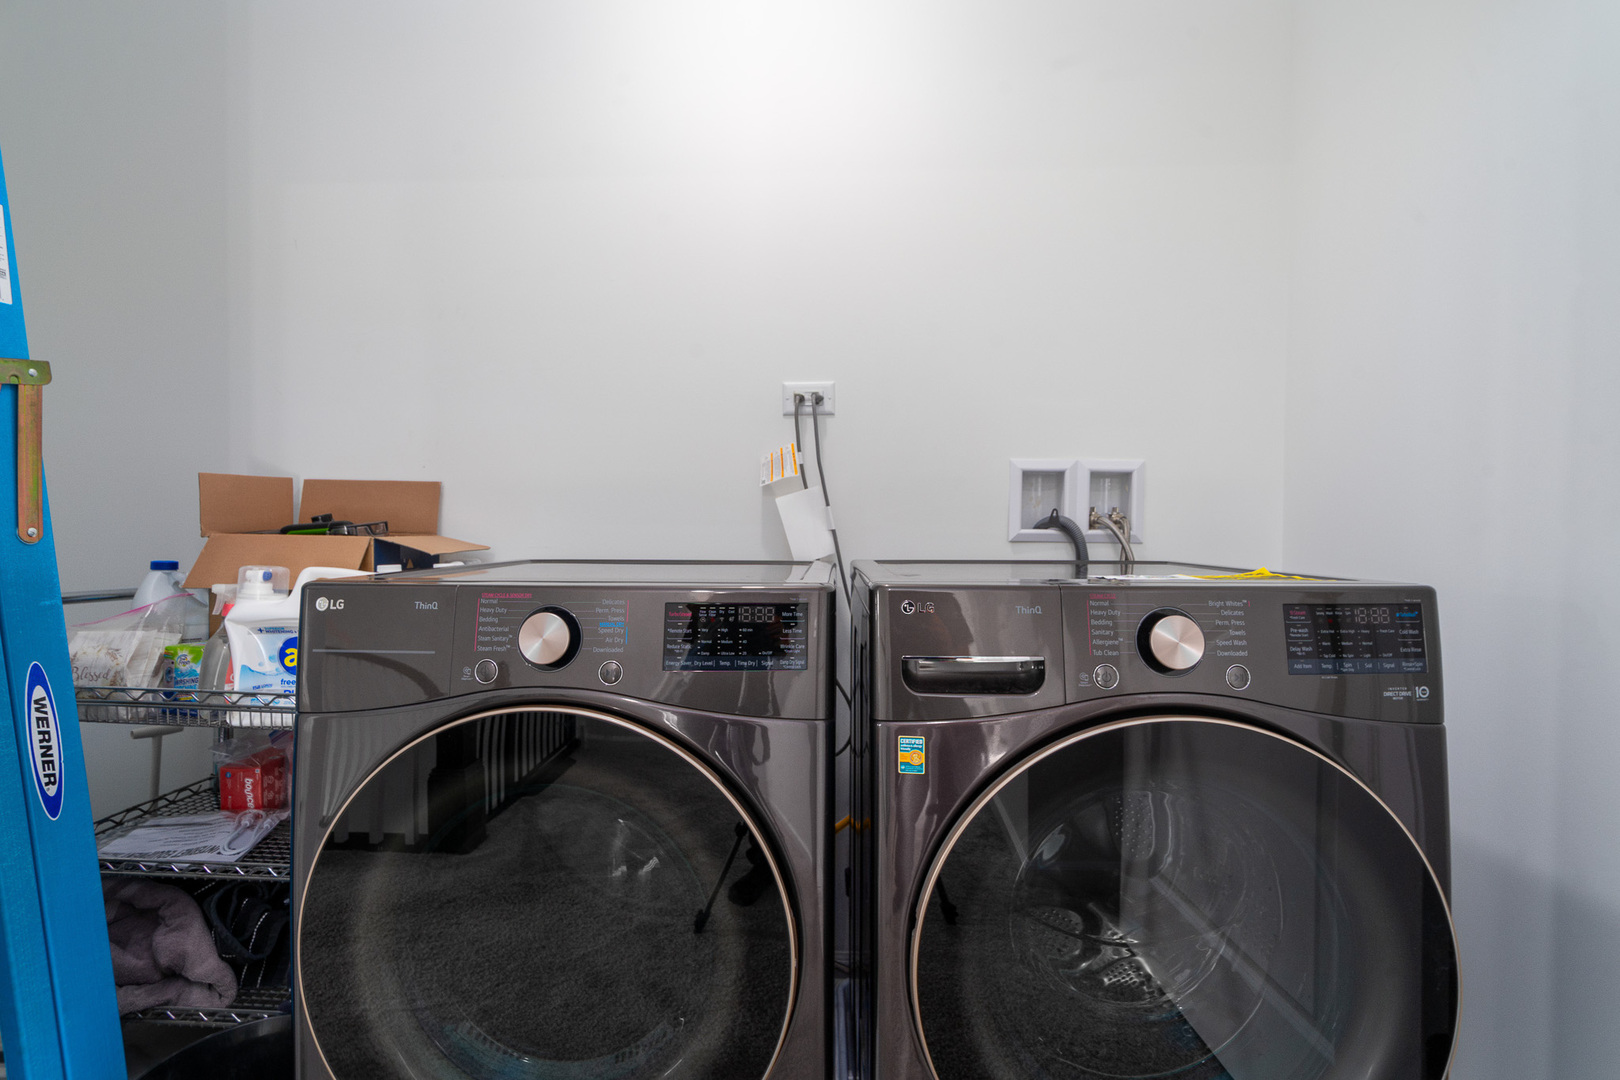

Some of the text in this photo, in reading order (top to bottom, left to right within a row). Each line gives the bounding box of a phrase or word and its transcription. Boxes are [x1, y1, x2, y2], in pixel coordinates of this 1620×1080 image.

[330, 600, 345, 610] LG
[414, 601, 438, 610] ThinQ
[917, 602, 935, 613] LG
[1015, 606, 1042, 614] ThinQ
[72, 666, 112, 682] Blessed
[1415, 686, 1429, 698] 10
[33, 696, 57, 788] WERNER
[244, 778, 254, 809] bounce
